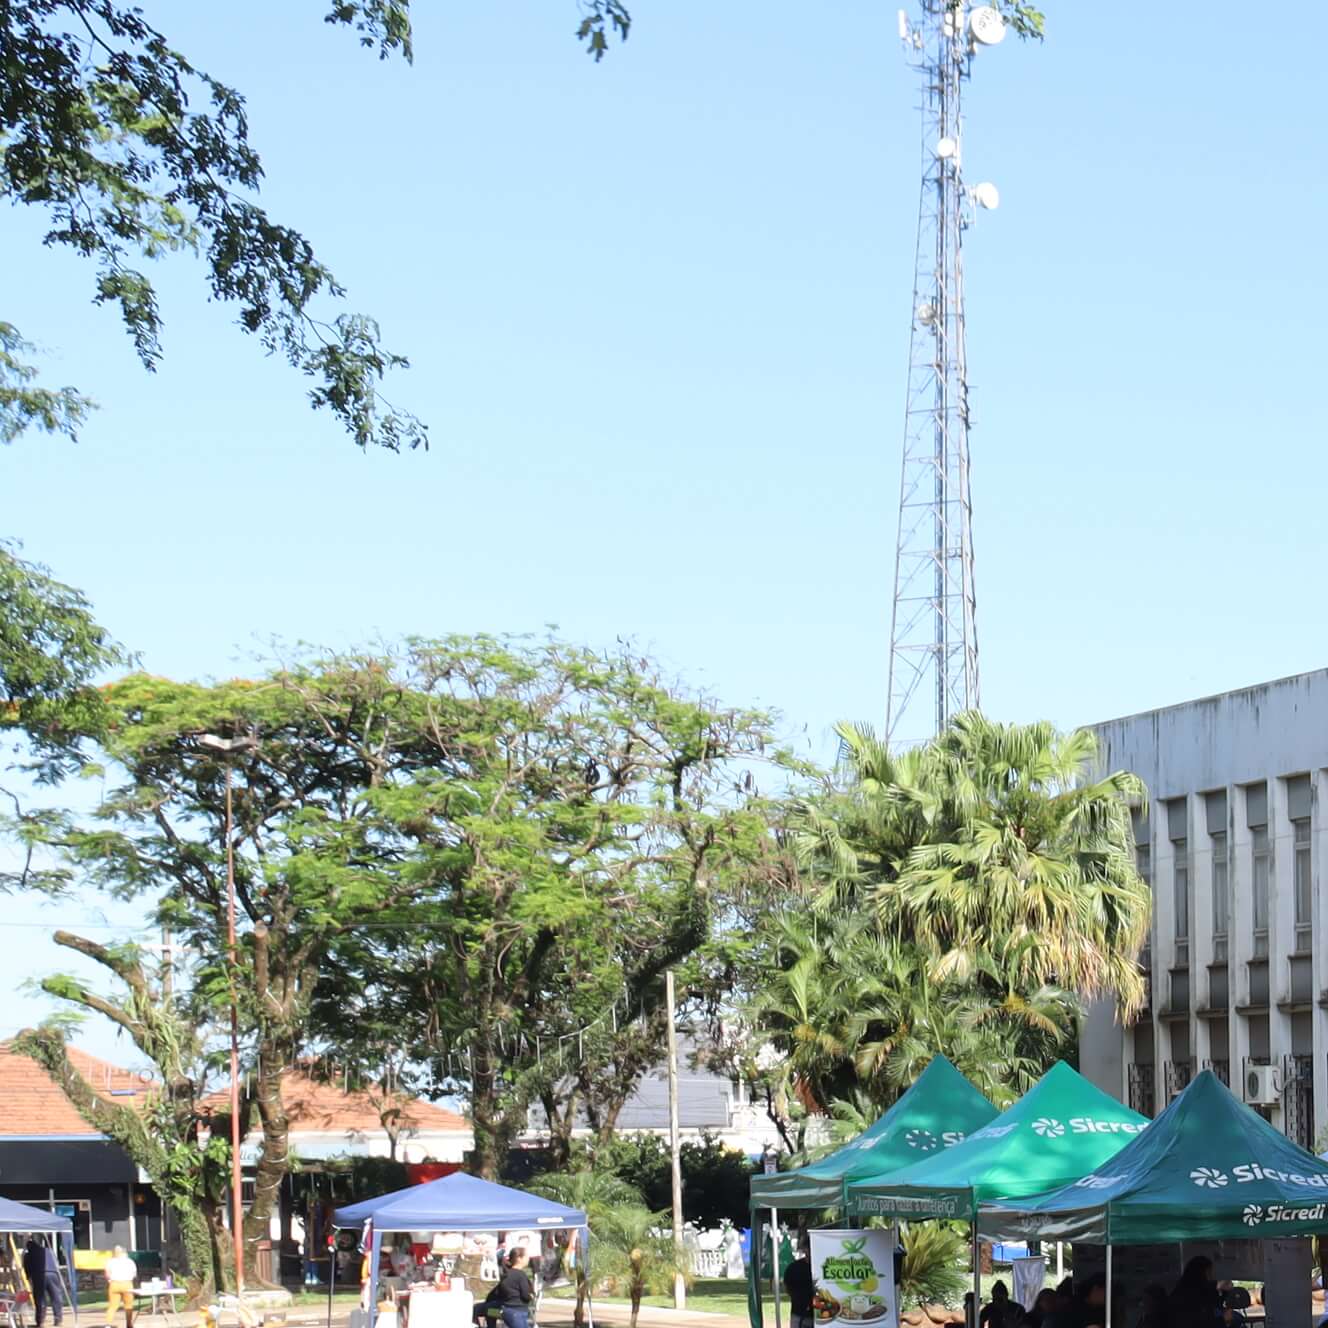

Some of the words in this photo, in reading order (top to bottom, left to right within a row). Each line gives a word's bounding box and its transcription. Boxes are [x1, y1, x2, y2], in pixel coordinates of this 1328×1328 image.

[1069, 1118, 1151, 1134] Sicre
[1265, 1203, 1326, 1221] Sicredi
[823, 1265, 870, 1280] Escolar
